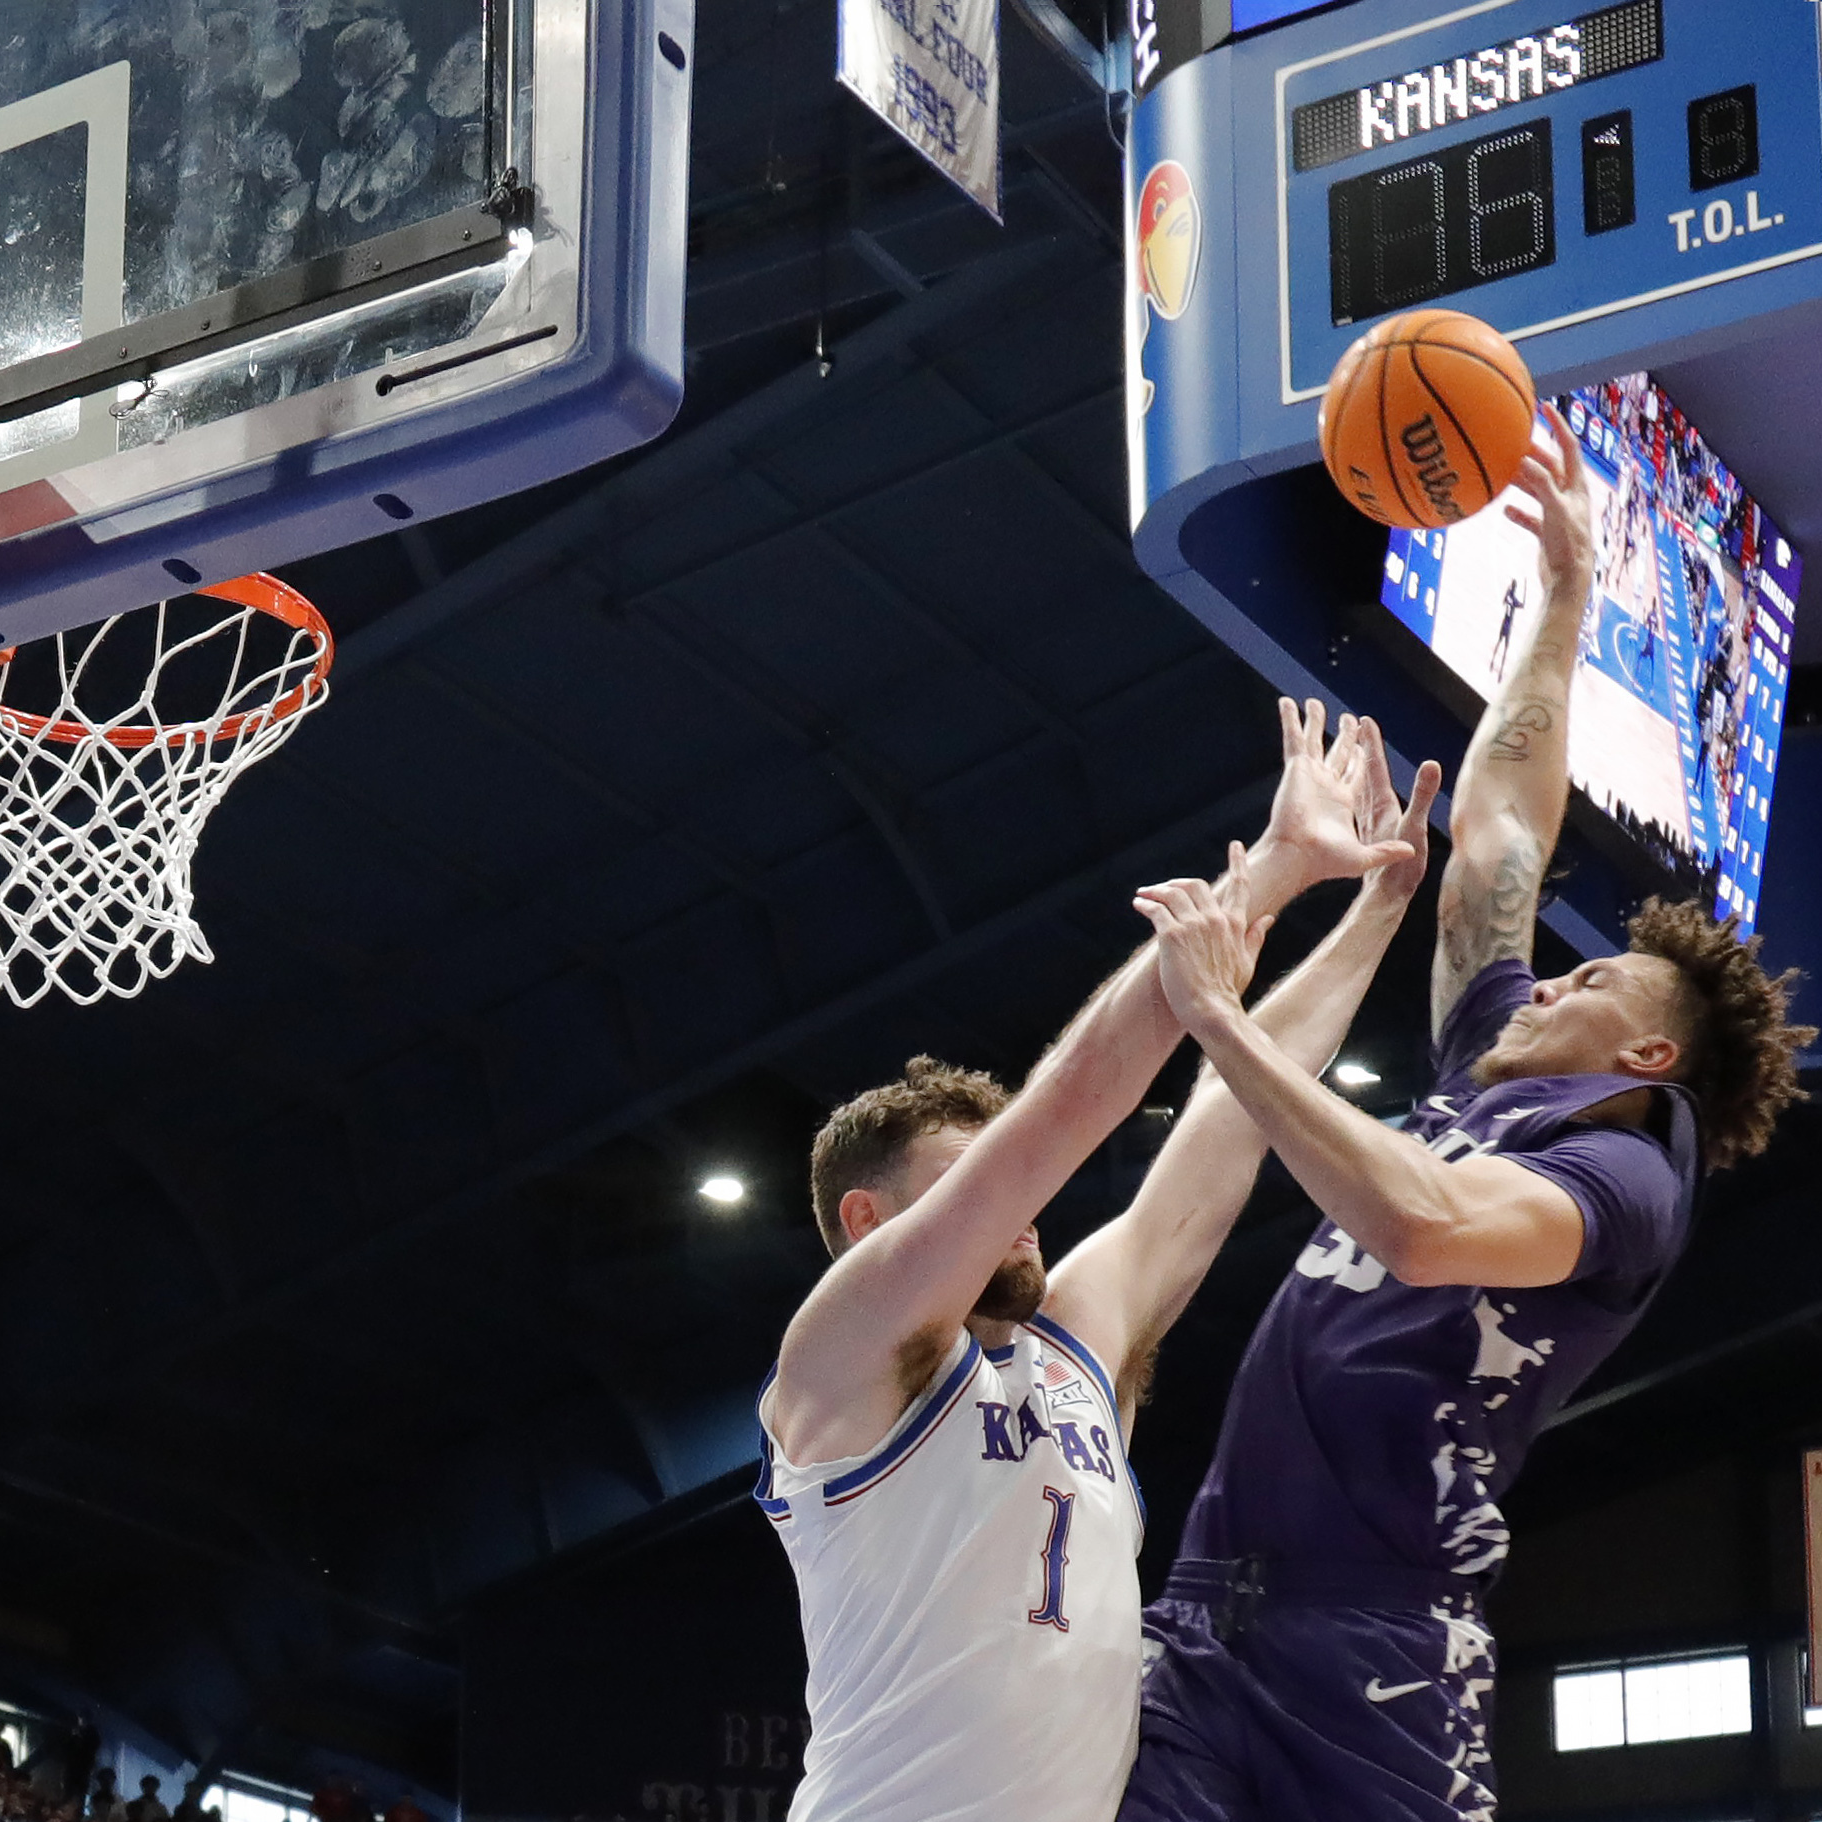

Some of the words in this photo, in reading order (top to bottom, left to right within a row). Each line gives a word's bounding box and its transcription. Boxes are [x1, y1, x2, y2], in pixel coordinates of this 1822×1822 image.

[1359, 22, 1581, 149] KANSAS
[1668, 189, 1786, 254] T.O.L.
[976, 1398, 1116, 1484] KAAS
[1028, 1484, 1077, 1634] 1
